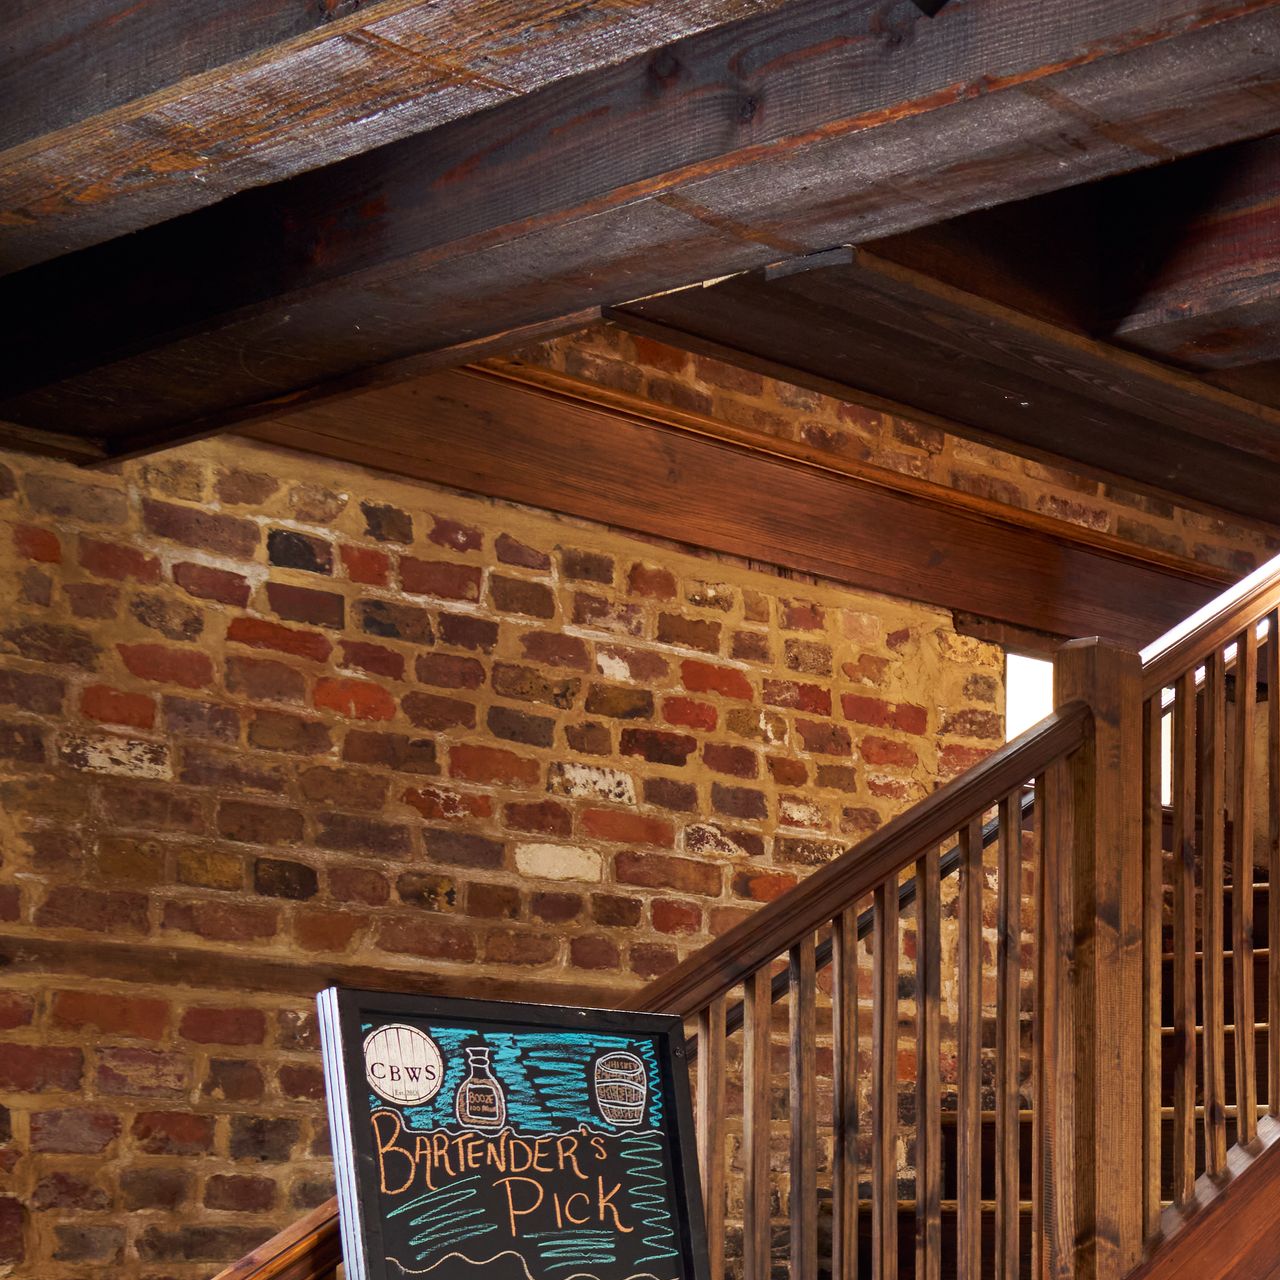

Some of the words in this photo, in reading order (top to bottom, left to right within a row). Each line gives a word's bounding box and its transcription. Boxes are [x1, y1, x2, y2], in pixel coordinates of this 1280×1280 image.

[370, 1062, 437, 1083] CBWS
[469, 1091, 495, 1104] BOOZE
[492, 1176, 634, 1237] PICK
